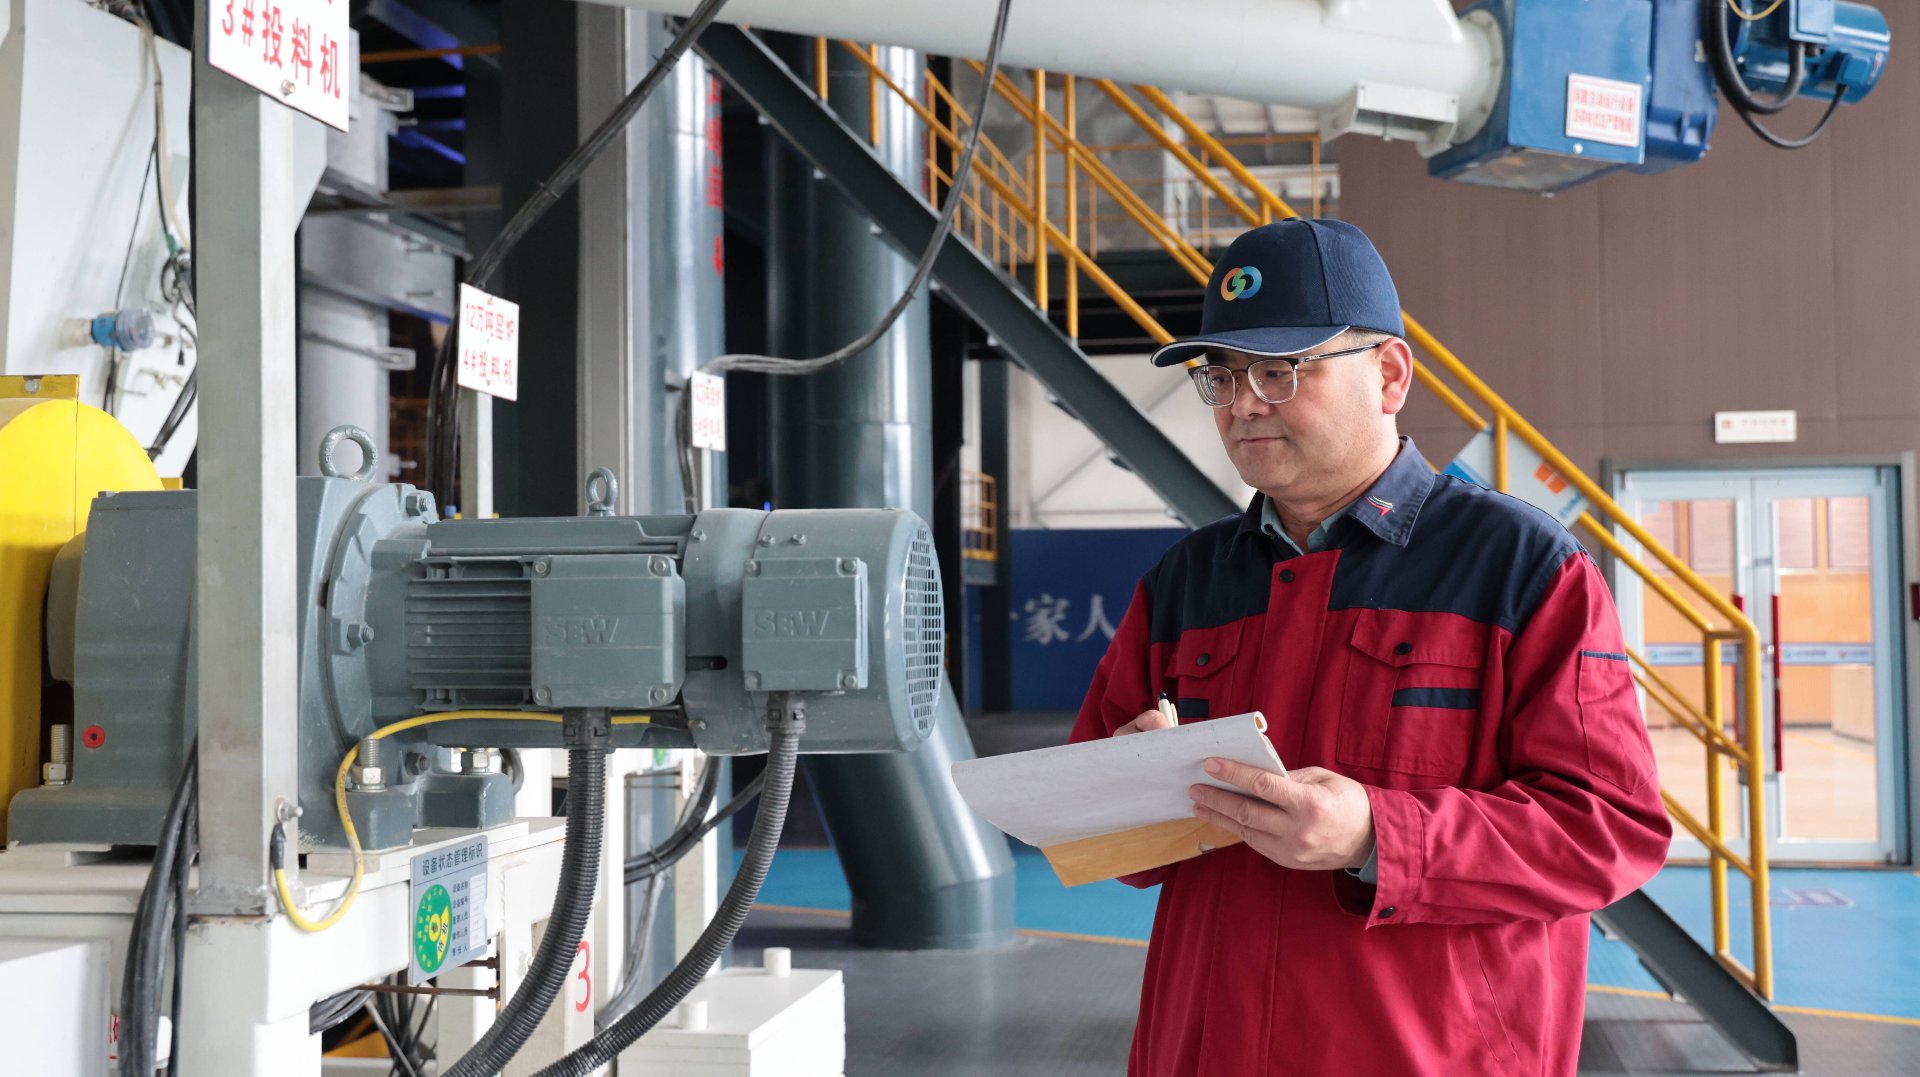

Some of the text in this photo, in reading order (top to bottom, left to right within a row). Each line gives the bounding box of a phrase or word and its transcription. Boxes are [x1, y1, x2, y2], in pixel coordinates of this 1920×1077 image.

[222, 0, 341, 99] 3#投料机
[549, 616, 619, 644] SEW
[753, 609, 830, 638] SEW
[1009, 593, 1117, 646] 家人
[422, 843, 483, 876] 设备状态管理标识
[575, 940, 591, 1013] 3
